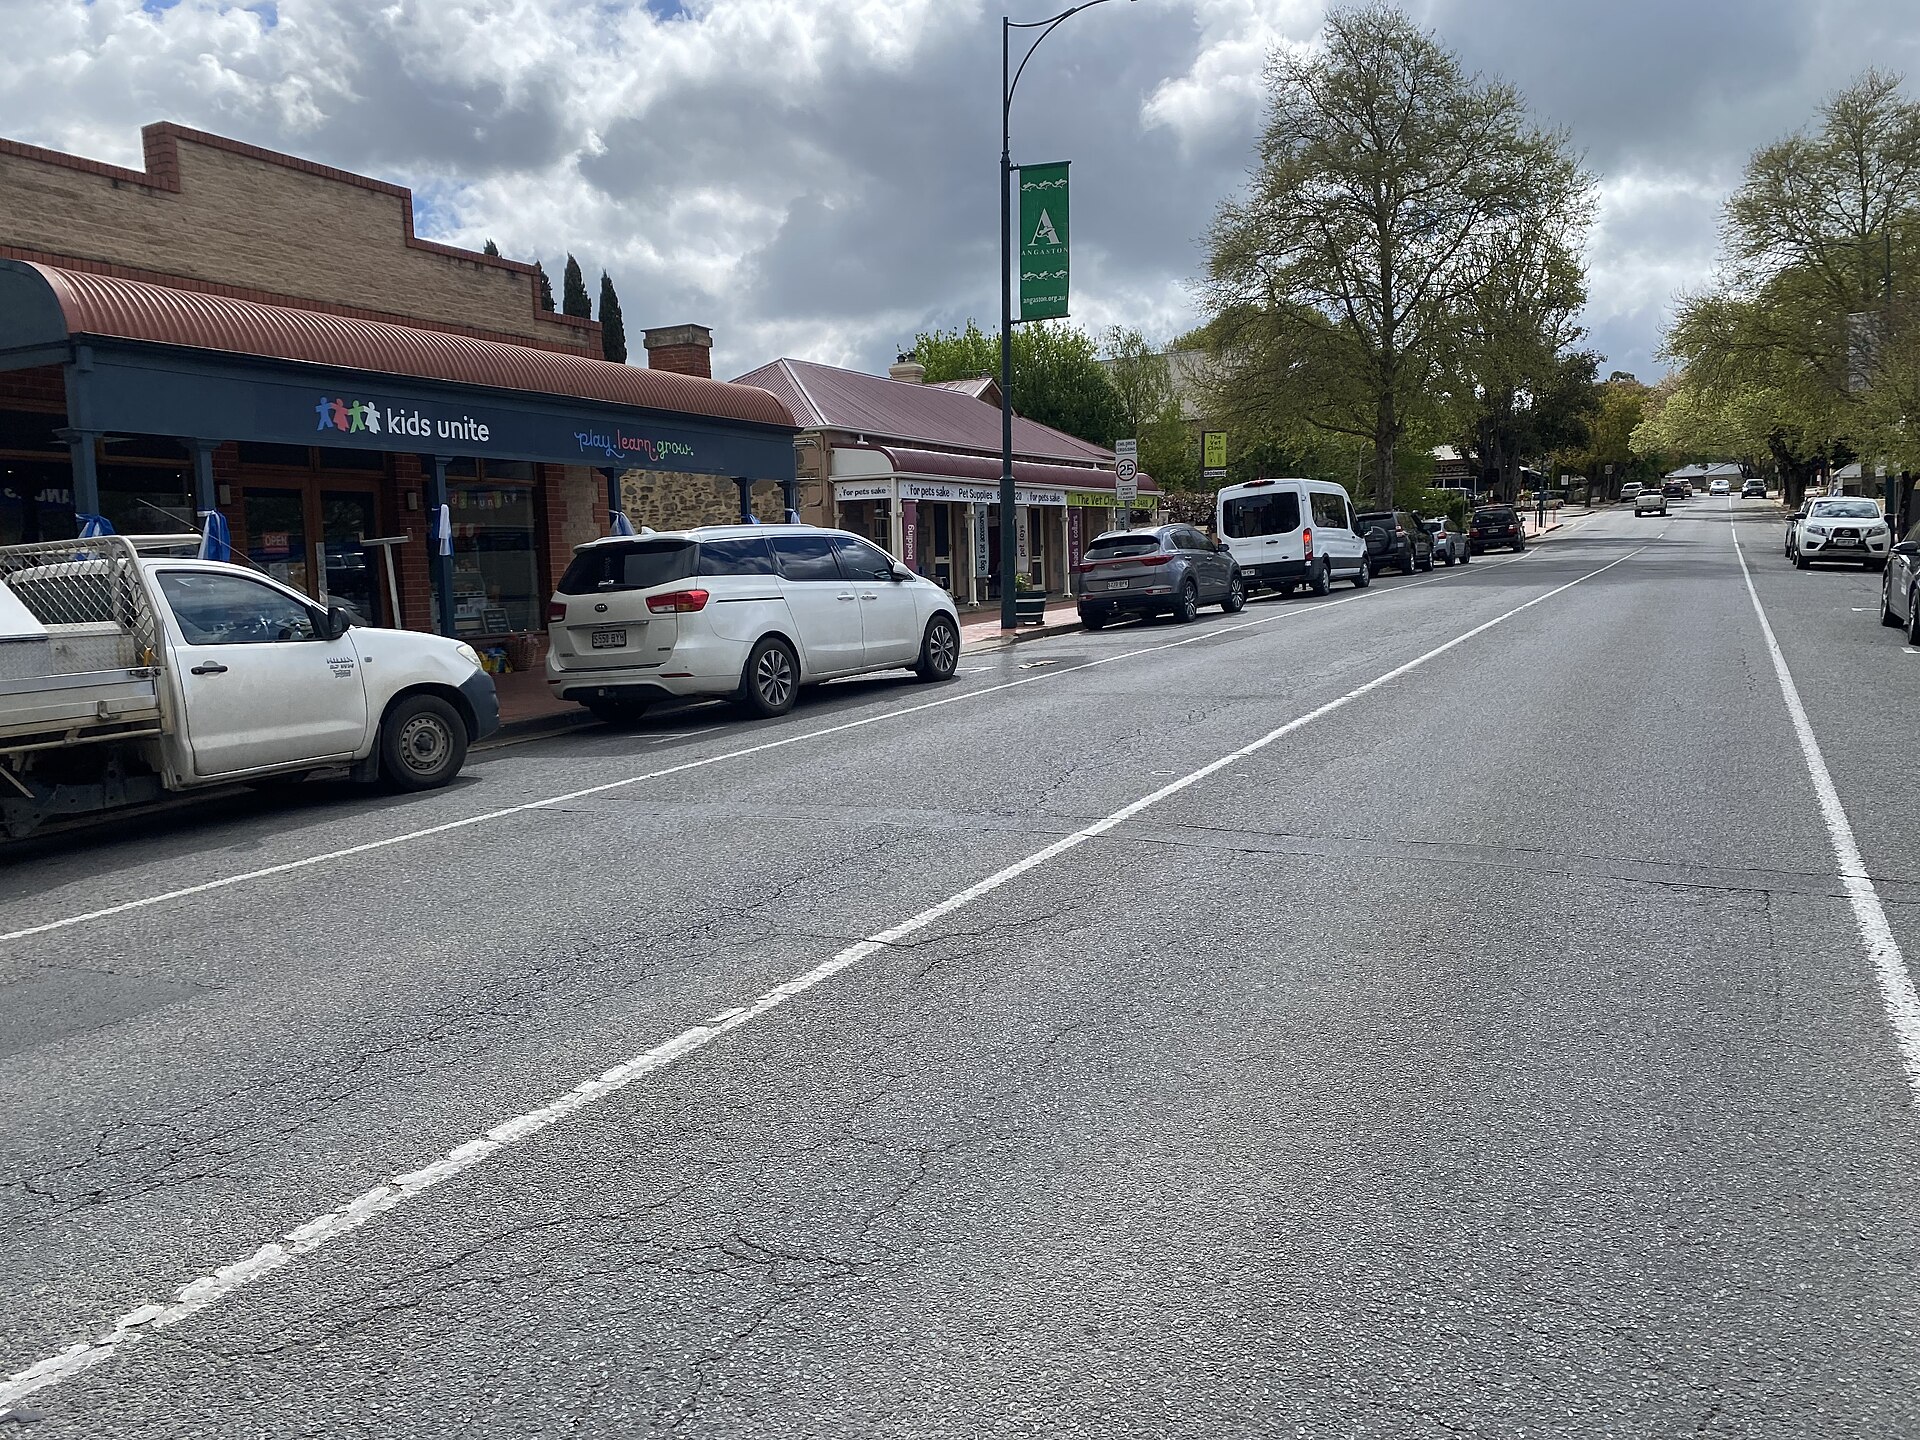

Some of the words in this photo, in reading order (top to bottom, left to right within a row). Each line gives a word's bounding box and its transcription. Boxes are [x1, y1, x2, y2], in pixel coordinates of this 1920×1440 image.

[1021, 247, 1068, 256] ANGASTON
[1023, 295, 1066, 305] angaston.org.au
[387, 408, 431, 437] kids
[437, 416, 490, 442] unite
[1119, 464, 1134, 476] 25
[855, 487, 870, 497] pets
[870, 487, 887, 496] sake
[909, 484, 921, 496] for
[921, 486, 935, 499] pets
[935, 486, 950, 498] sake
[958, 488, 969, 499] Pet
[969, 488, 993, 501] Supplies
[1030, 491, 1038, 501] for
[1038, 493, 1050, 503] pets
[1049, 493, 1061, 503] sake
[1076, 493, 1090, 505] The
[1091, 494, 1103, 506] Vet
[978, 510, 986, 543] accessories
[1071, 514, 1079, 539] collars
[264, 535, 288, 546] OPEN
[905, 524, 915, 560] bedding
[1019, 544, 1027, 557] pet
[1071, 548, 1079, 567] leads
[978, 560, 987, 572] dog
